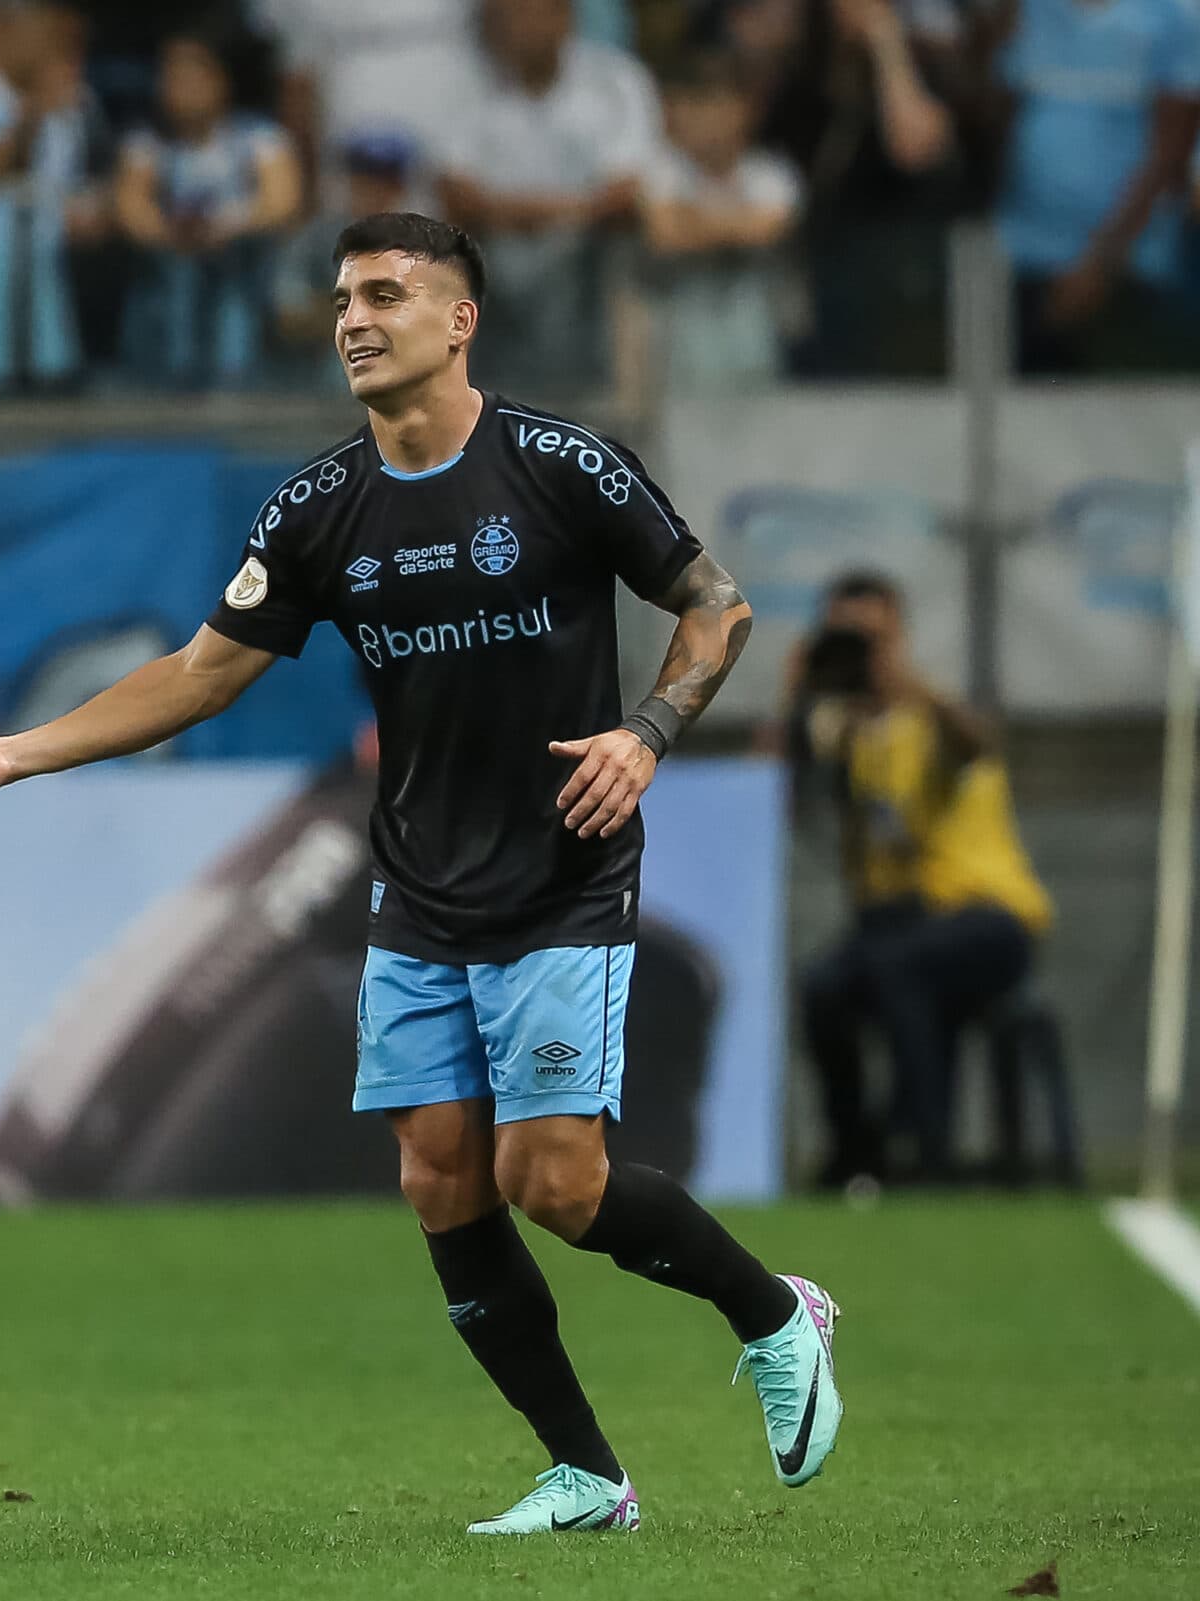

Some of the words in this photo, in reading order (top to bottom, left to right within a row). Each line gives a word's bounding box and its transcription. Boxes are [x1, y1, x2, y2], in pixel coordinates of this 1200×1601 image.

[518, 424, 603, 474] vero
[249, 480, 311, 549] vero
[393, 543, 457, 563] Esportes
[381, 597, 552, 658] banrisul
[535, 1064, 577, 1076] umbro
